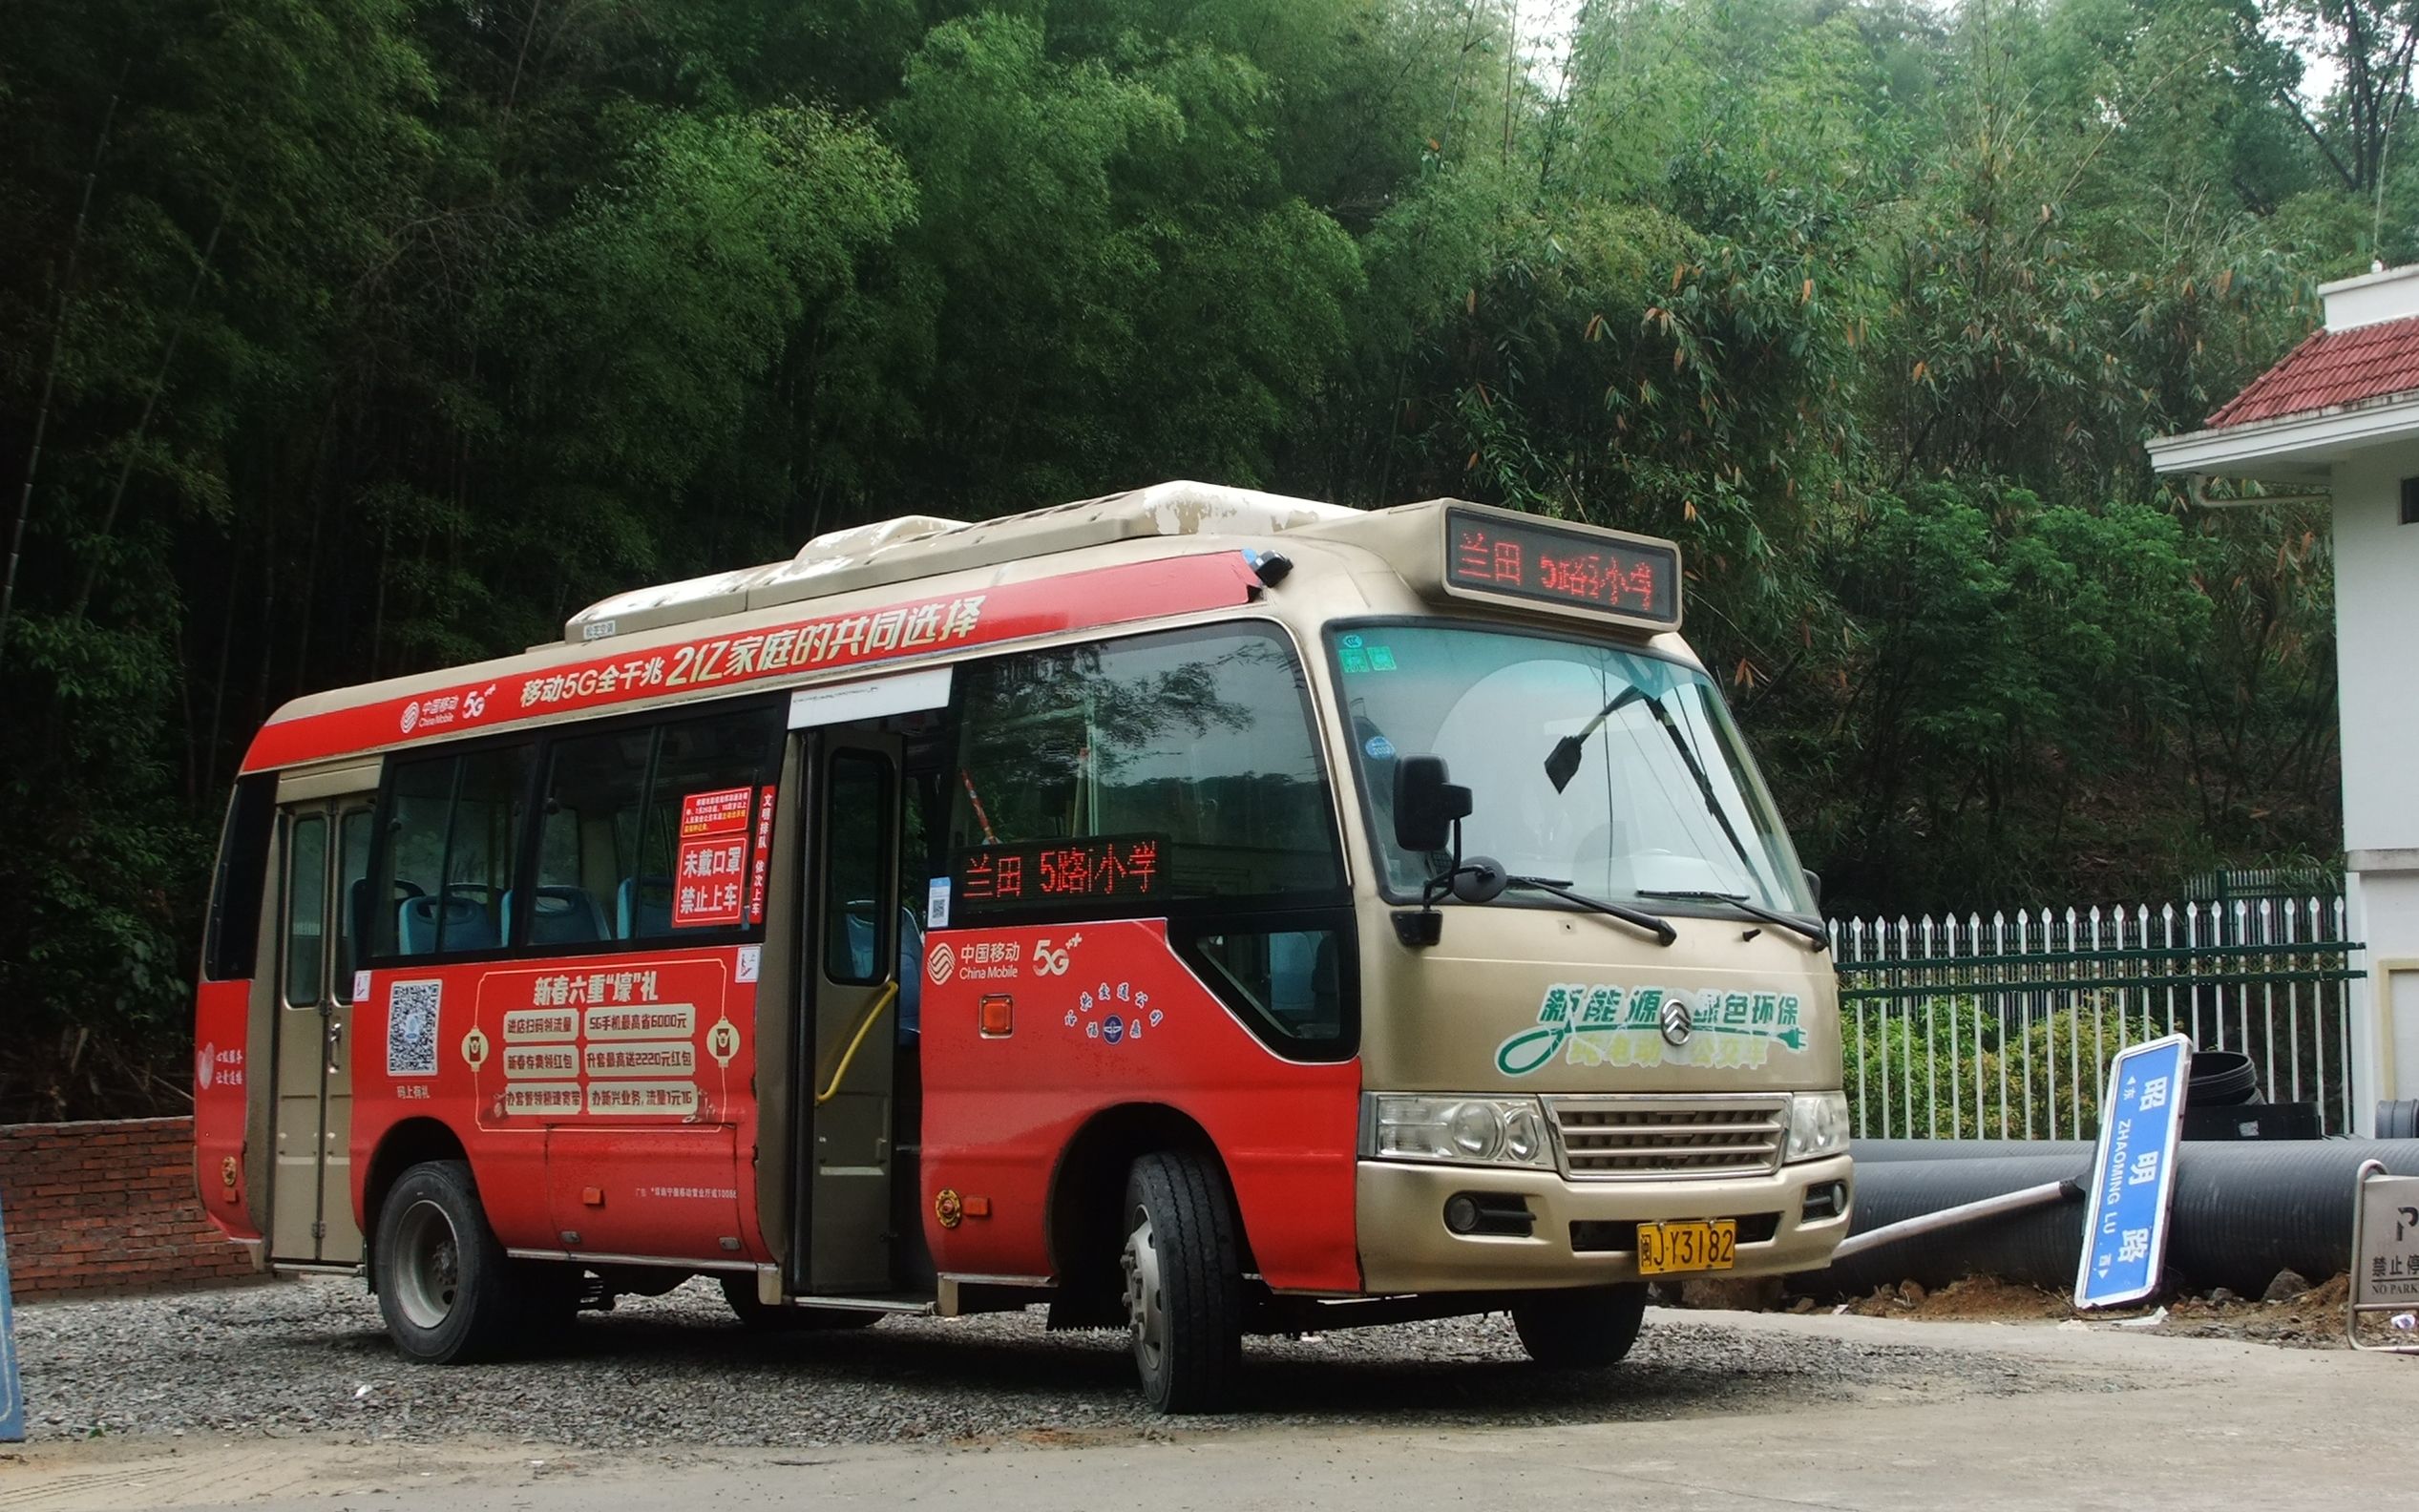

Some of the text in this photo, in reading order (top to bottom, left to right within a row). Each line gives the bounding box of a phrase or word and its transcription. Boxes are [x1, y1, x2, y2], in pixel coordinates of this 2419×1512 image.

[1459, 533, 1522, 585] 兰田
[520, 596, 987, 708] 移动5G全千兆 2亿家庭的共同选择
[422, 695, 459, 715] 中国移动
[683, 846, 743, 878] 未戴口罩
[963, 853, 1022, 897] 兰田
[680, 883, 739, 914] 禁止上车
[960, 941, 1020, 963] 中国移动
[959, 963, 1019, 979] China Mobile
[1540, 989, 1664, 1022] 新能源
[507, 1017, 573, 1034] 进店扫码领流量
[589, 1013, 687, 1031] 5G手机最高省6000元
[396, 1084, 431, 1099] 码上有礼
[2102, 1118, 2132, 1235] ZHAOMING LU
[2117, 1076, 2168, 1264] 昭明路
[2372, 1284, 2387, 1295] NO
